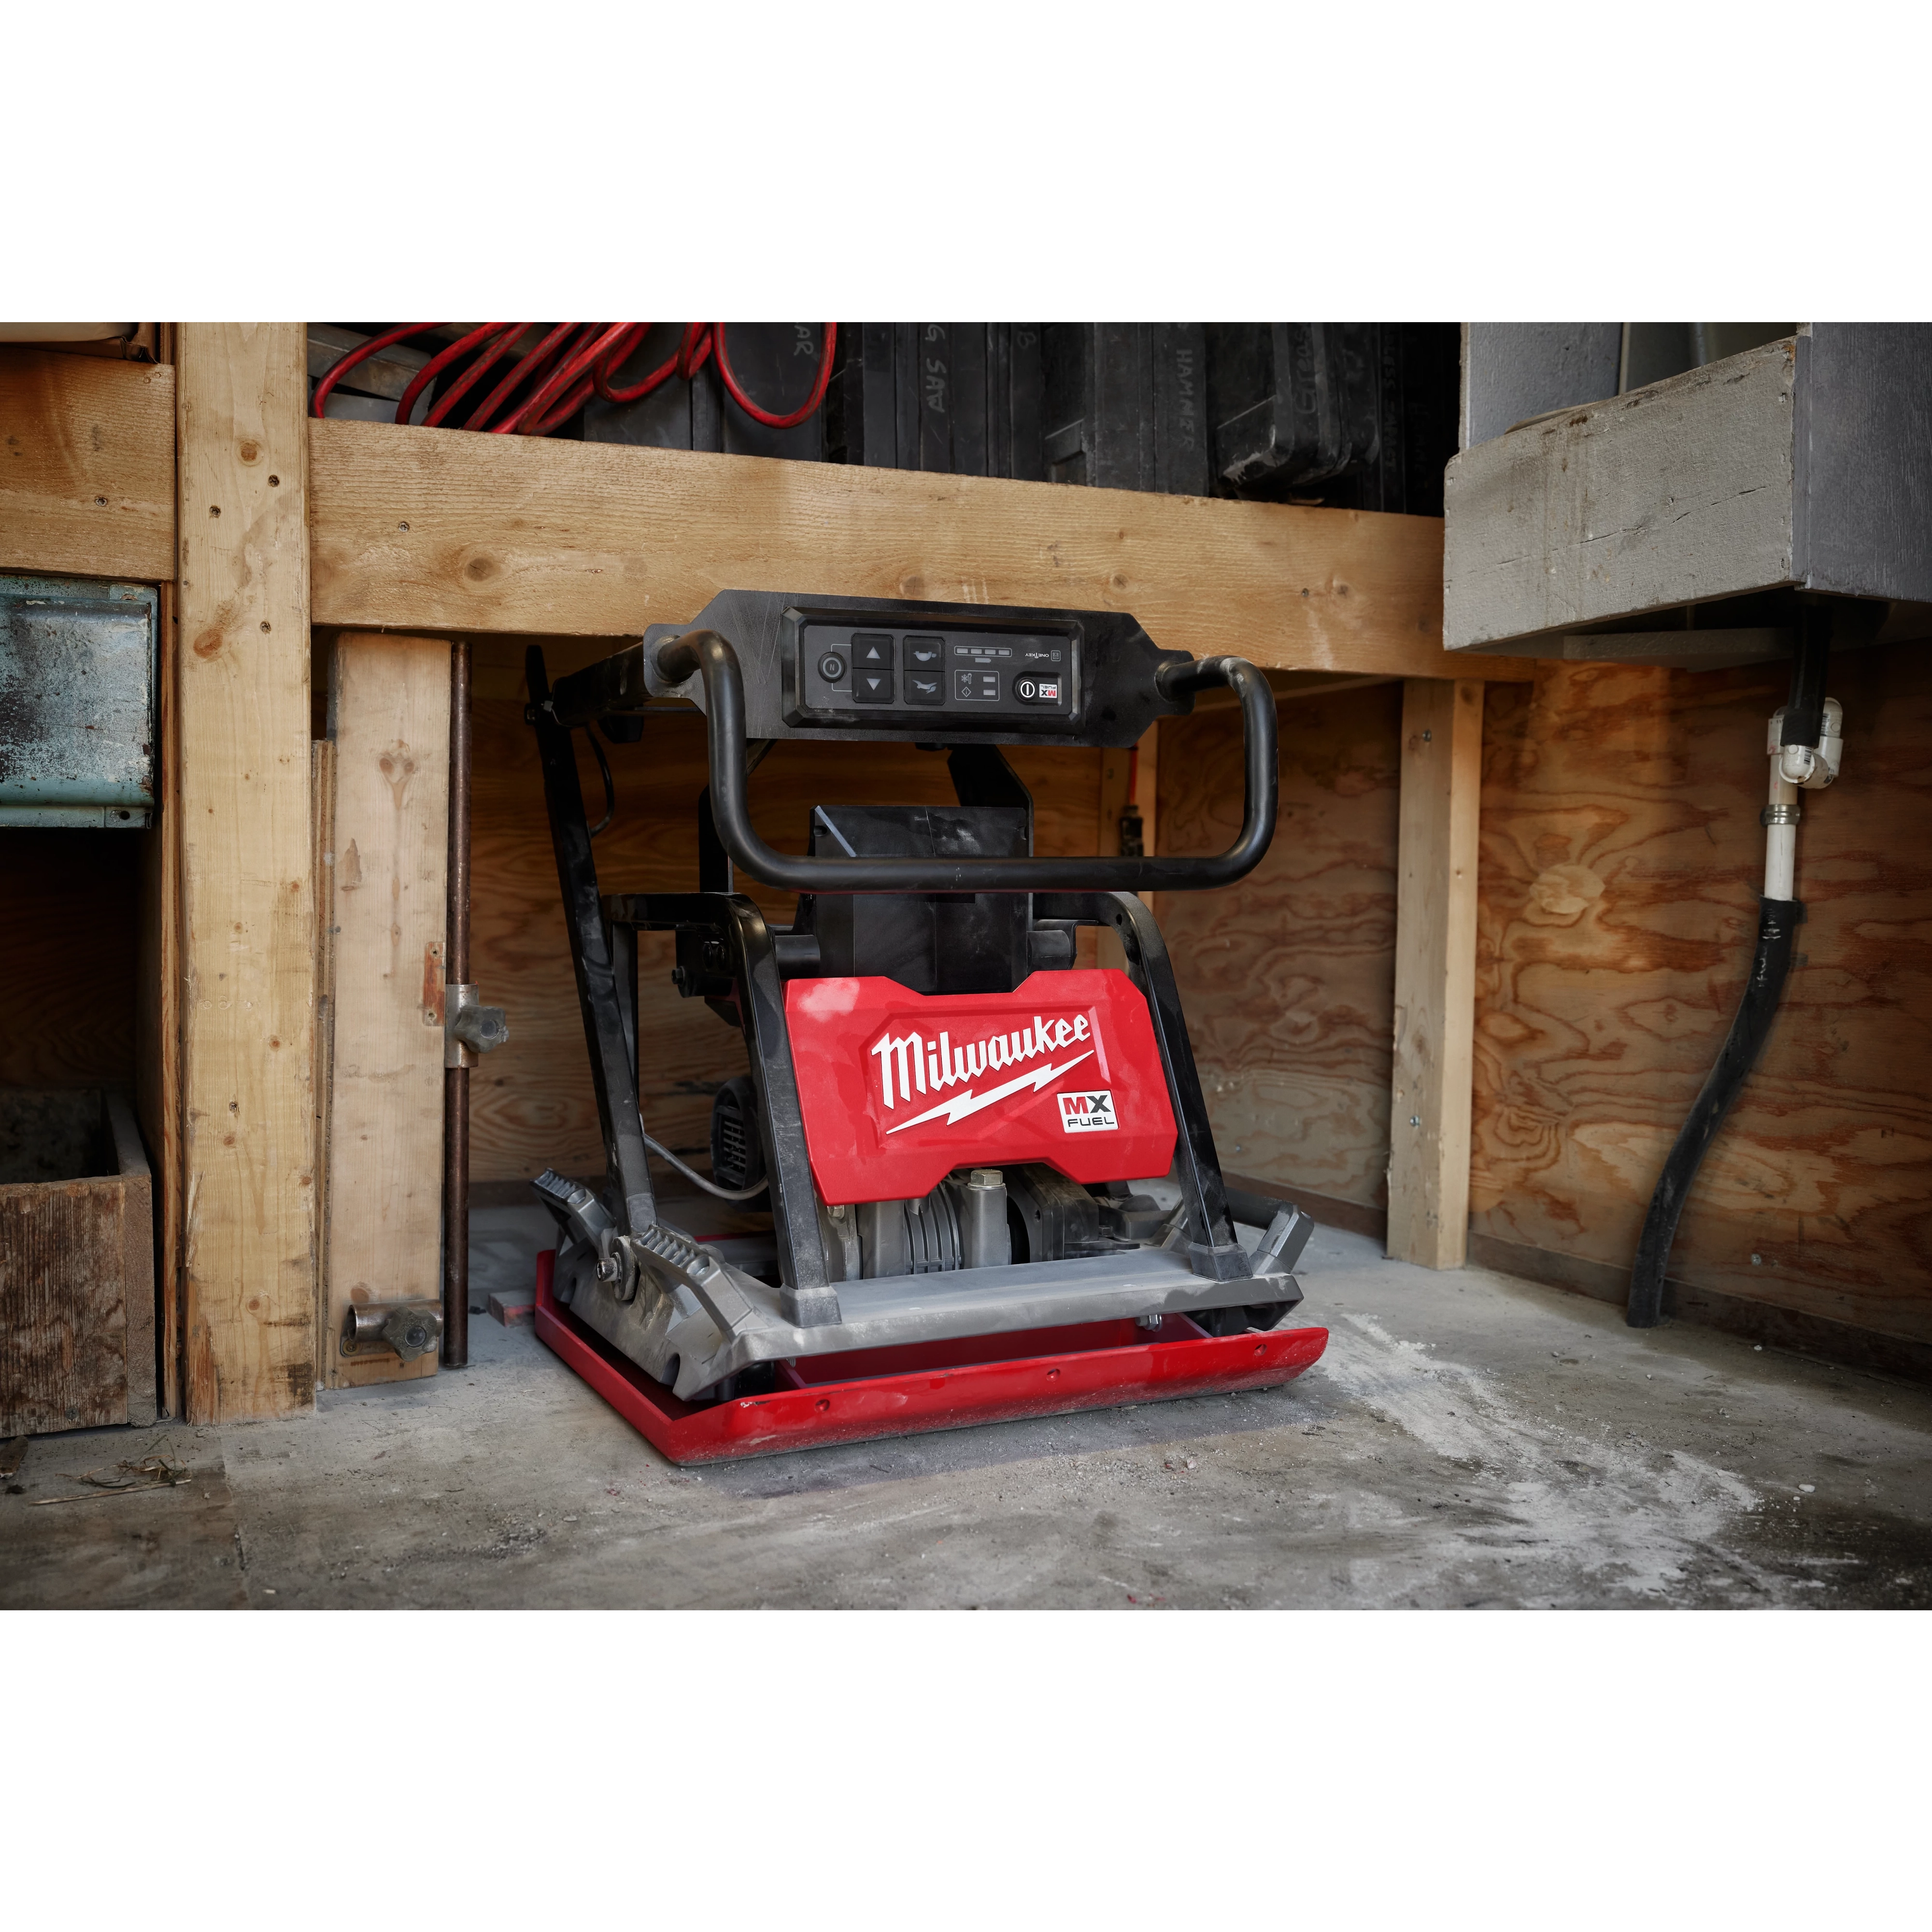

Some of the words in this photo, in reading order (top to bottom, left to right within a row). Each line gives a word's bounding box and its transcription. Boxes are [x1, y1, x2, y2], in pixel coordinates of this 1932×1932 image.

[925, 357, 947, 413] SAW
[1176, 349, 1194, 449] HAMMER
[871, 1014, 1091, 1110] Milwaukee
[1063, 1094, 1111, 1115] MX
[1067, 1117, 1115, 1127] FUEL
